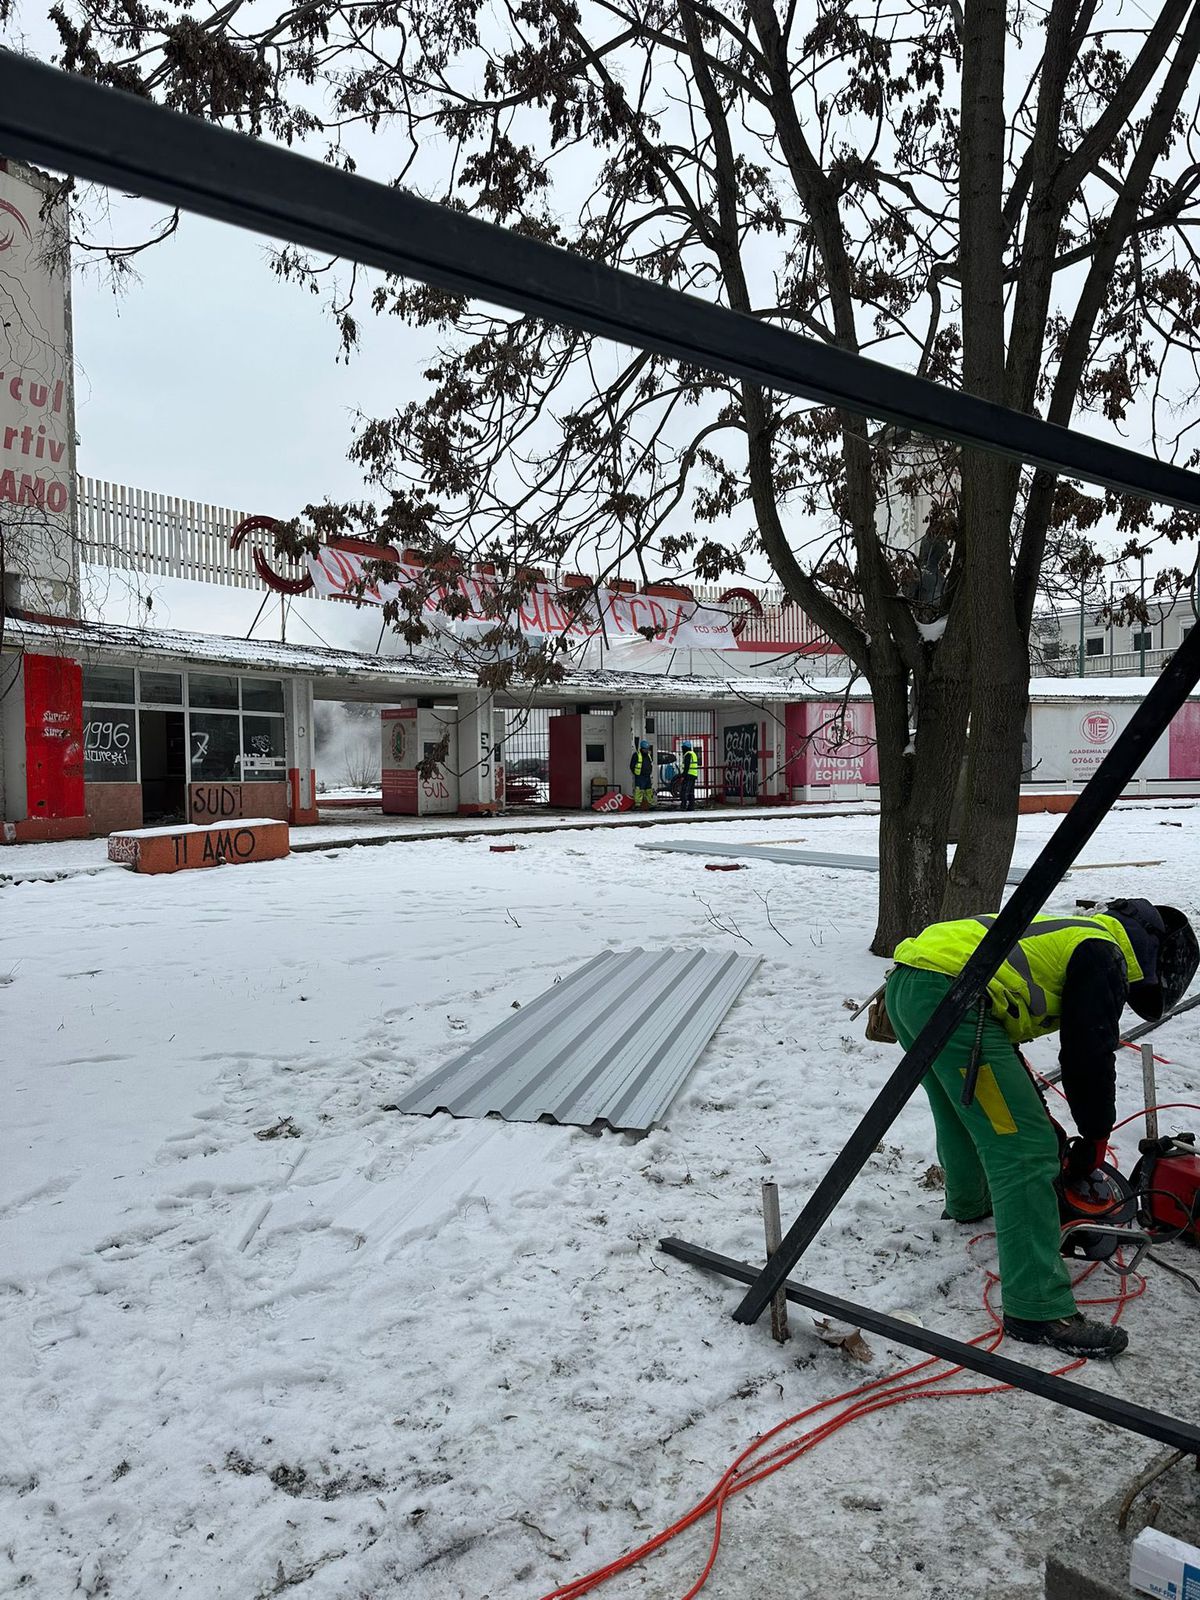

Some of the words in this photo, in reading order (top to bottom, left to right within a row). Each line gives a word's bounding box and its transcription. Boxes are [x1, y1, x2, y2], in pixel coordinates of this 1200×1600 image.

[4, 425, 66, 462] rtiv
[712, 625, 729, 634] SUD
[83, 722, 130, 750] 1996
[814, 757, 847, 768] VINO
[815, 767, 862, 780] ECHIPĂ
[193, 785, 243, 817] SUD!
[422, 780, 449, 799] SUD
[171, 832, 187, 865] TI
[202, 828, 256, 862] AMO
